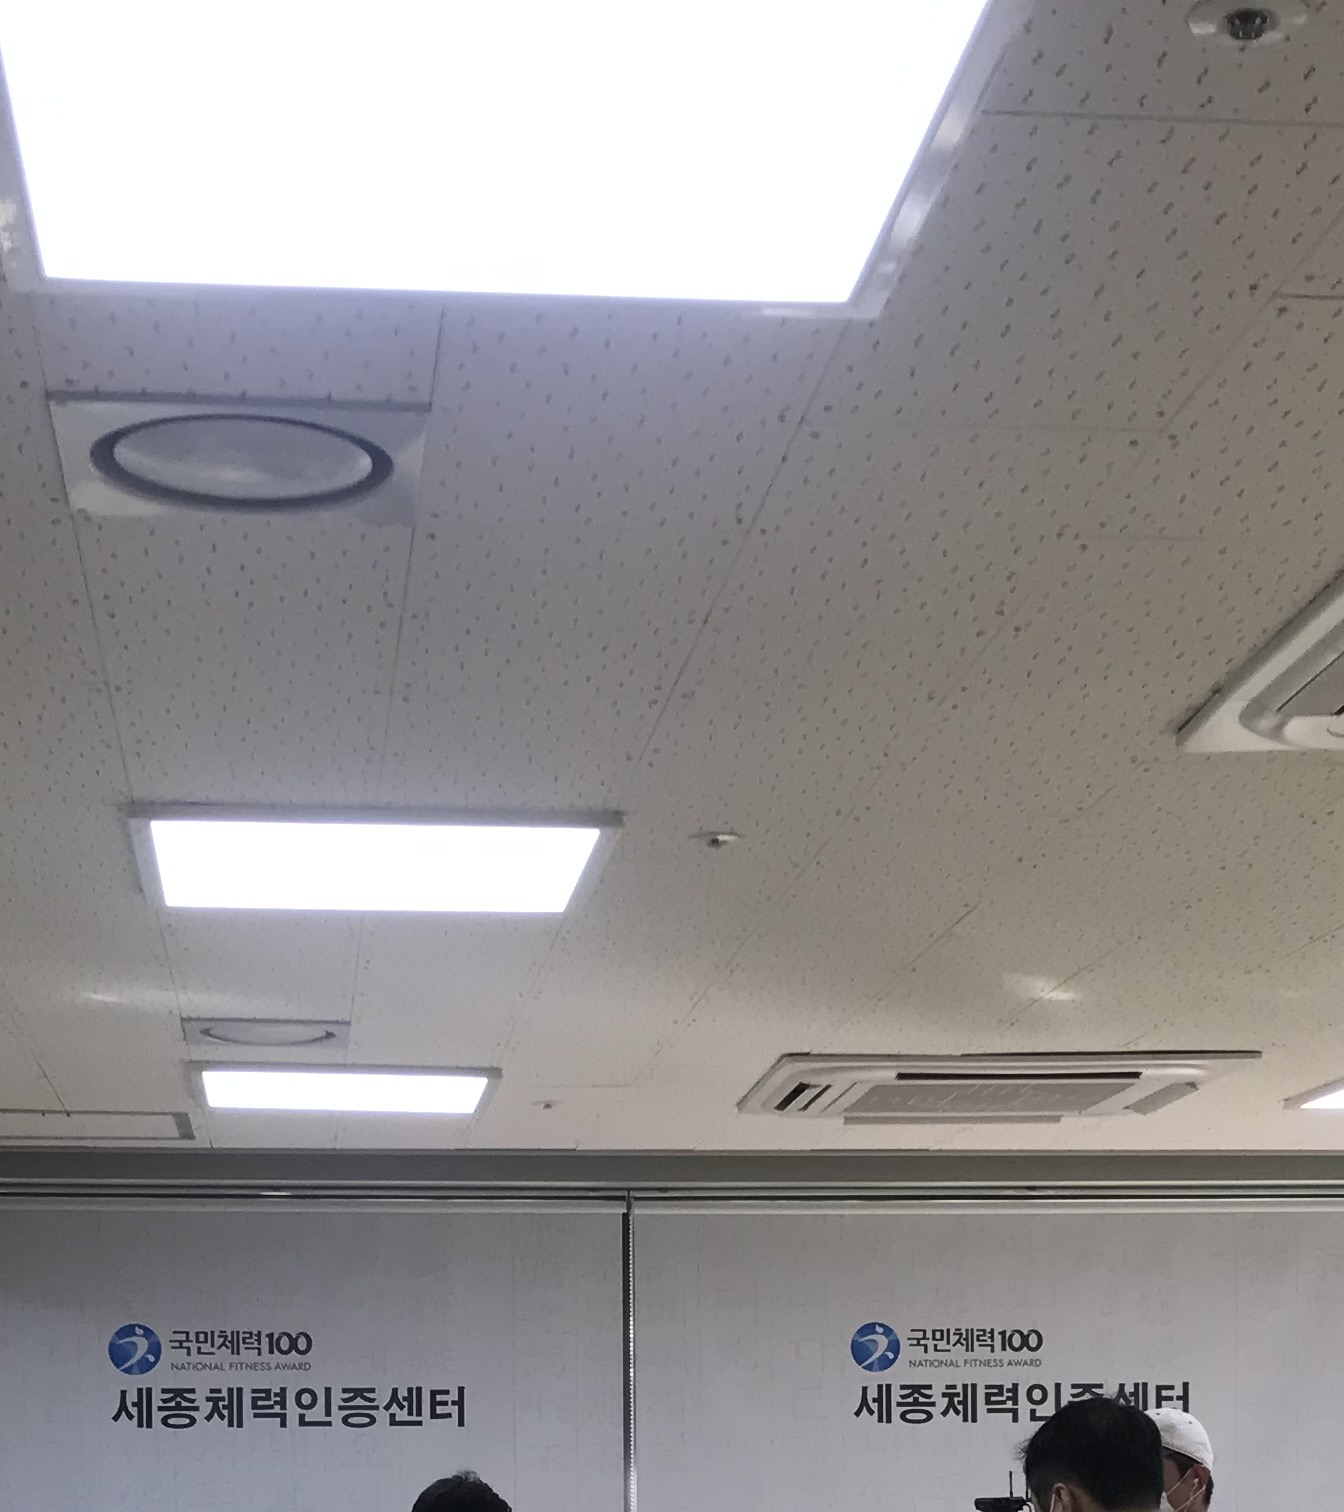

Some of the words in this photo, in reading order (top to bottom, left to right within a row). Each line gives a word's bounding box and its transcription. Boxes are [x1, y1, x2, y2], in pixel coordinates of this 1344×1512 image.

[169, 1330, 312, 1356] 국민체력100
[907, 1328, 1043, 1353] 국민체력100
[170, 1362, 226, 1372] NATIONAL
[229, 1362, 272, 1372] FITNESS
[274, 1362, 312, 1372] AWARD
[909, 1359, 961, 1369] NATIONAL
[964, 1359, 1004, 1368] FITNESS
[1007, 1358, 1042, 1368] AWARD
[111, 1385, 466, 1429] 세종체력인증센터
